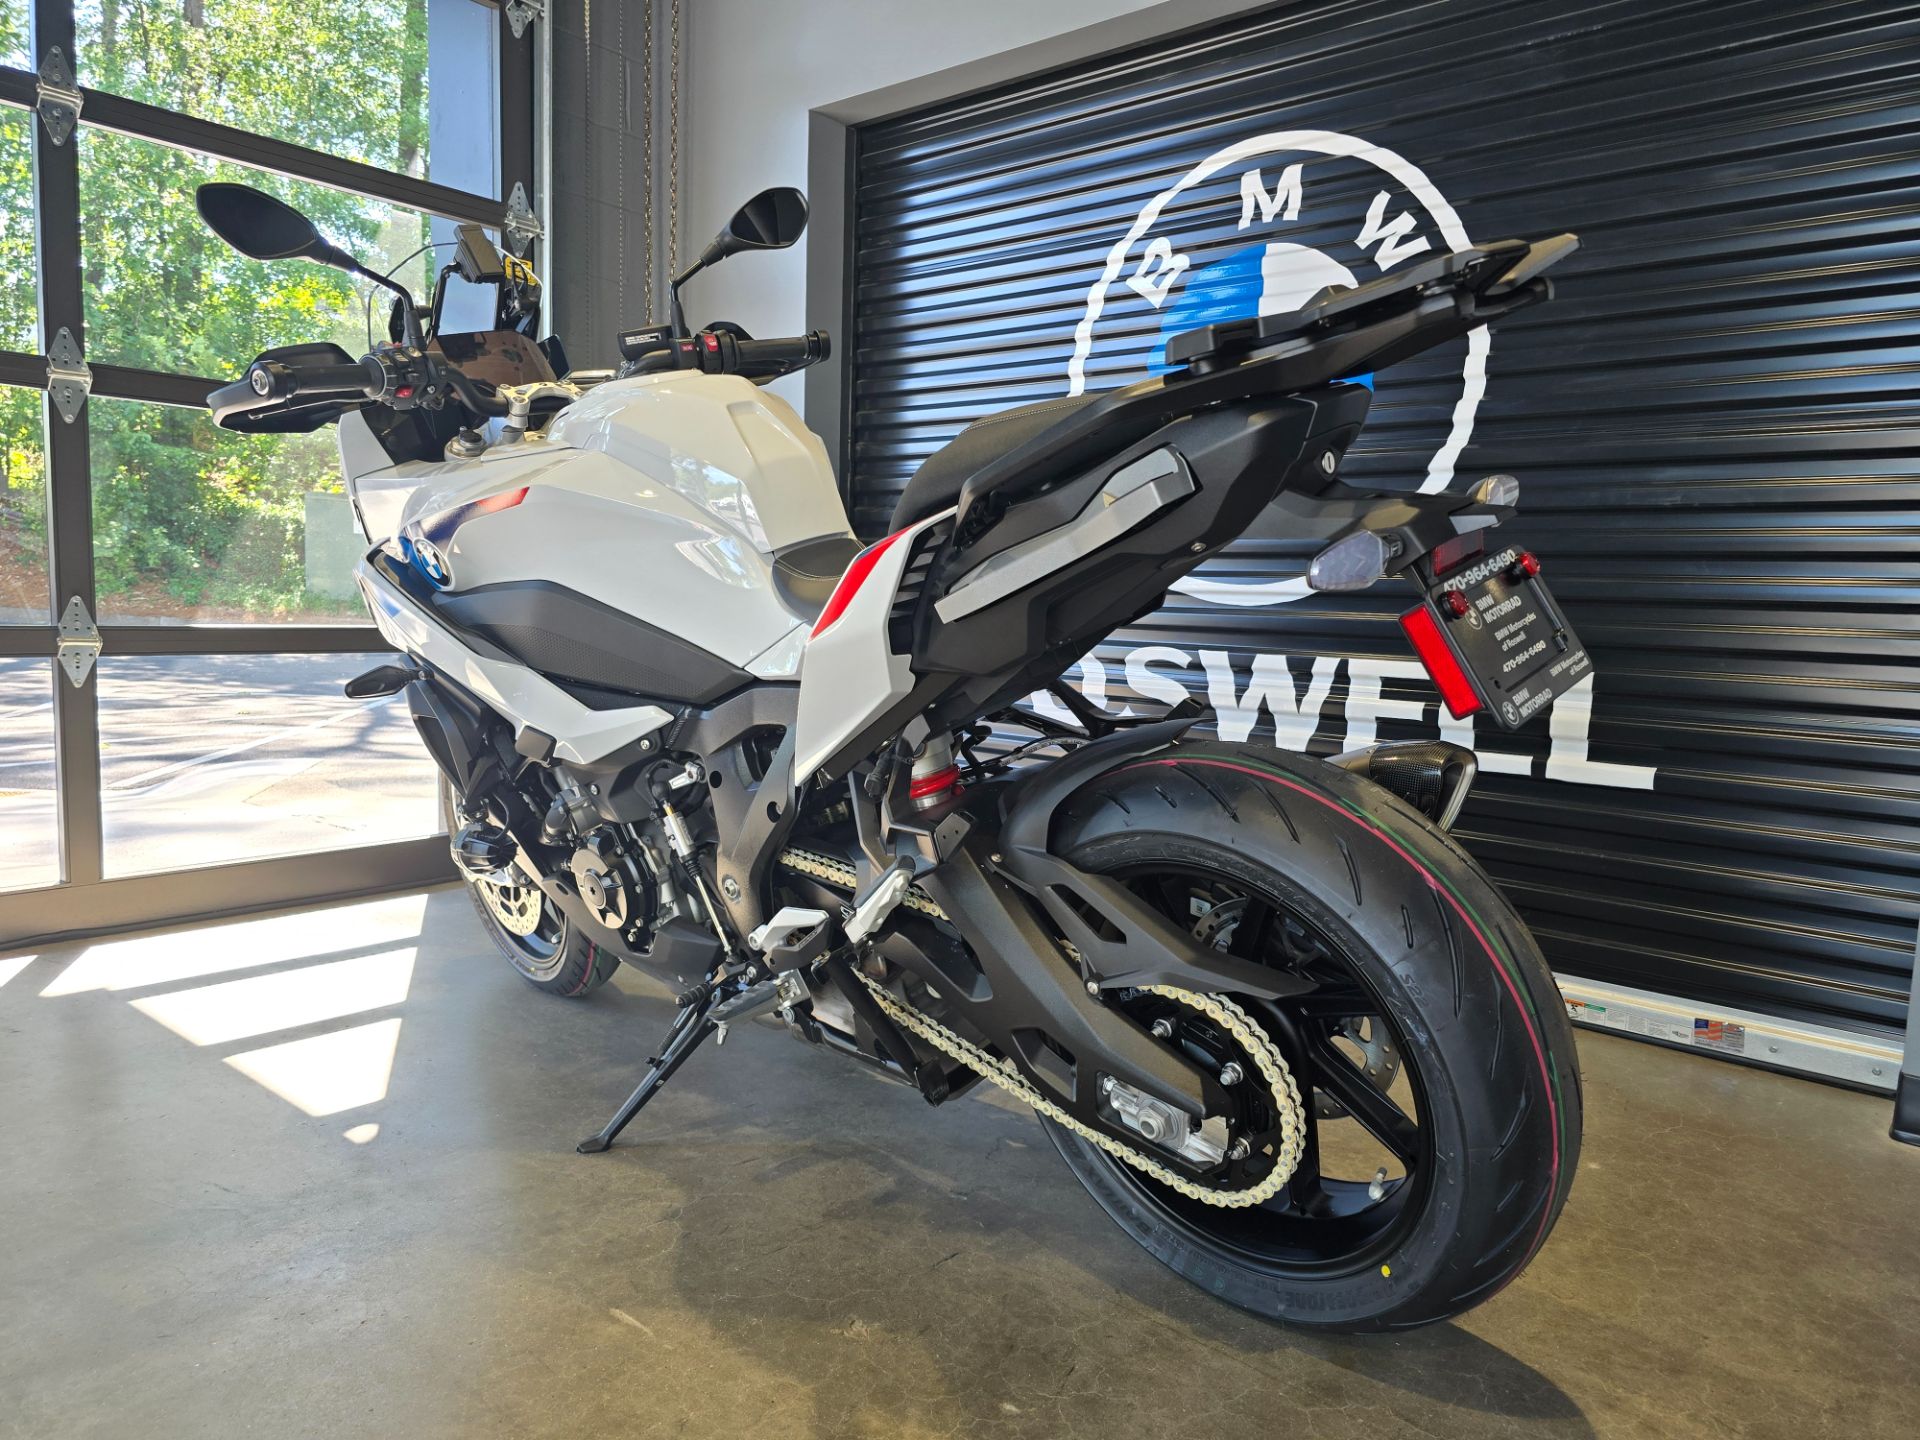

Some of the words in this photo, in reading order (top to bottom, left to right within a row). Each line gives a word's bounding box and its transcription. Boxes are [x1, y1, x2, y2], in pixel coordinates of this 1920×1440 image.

[1443, 549, 1515, 592] 470-964-6490
[1475, 594, 1495, 611] BMW
[1483, 595, 1521, 623] MOTORRAD
[1503, 640, 1546, 672] 470-964-6490
[1512, 687, 1530, 706] BMW
[1519, 688, 1553, 718] MOTORRAD
[1030, 646, 1657, 790] OSWELL
